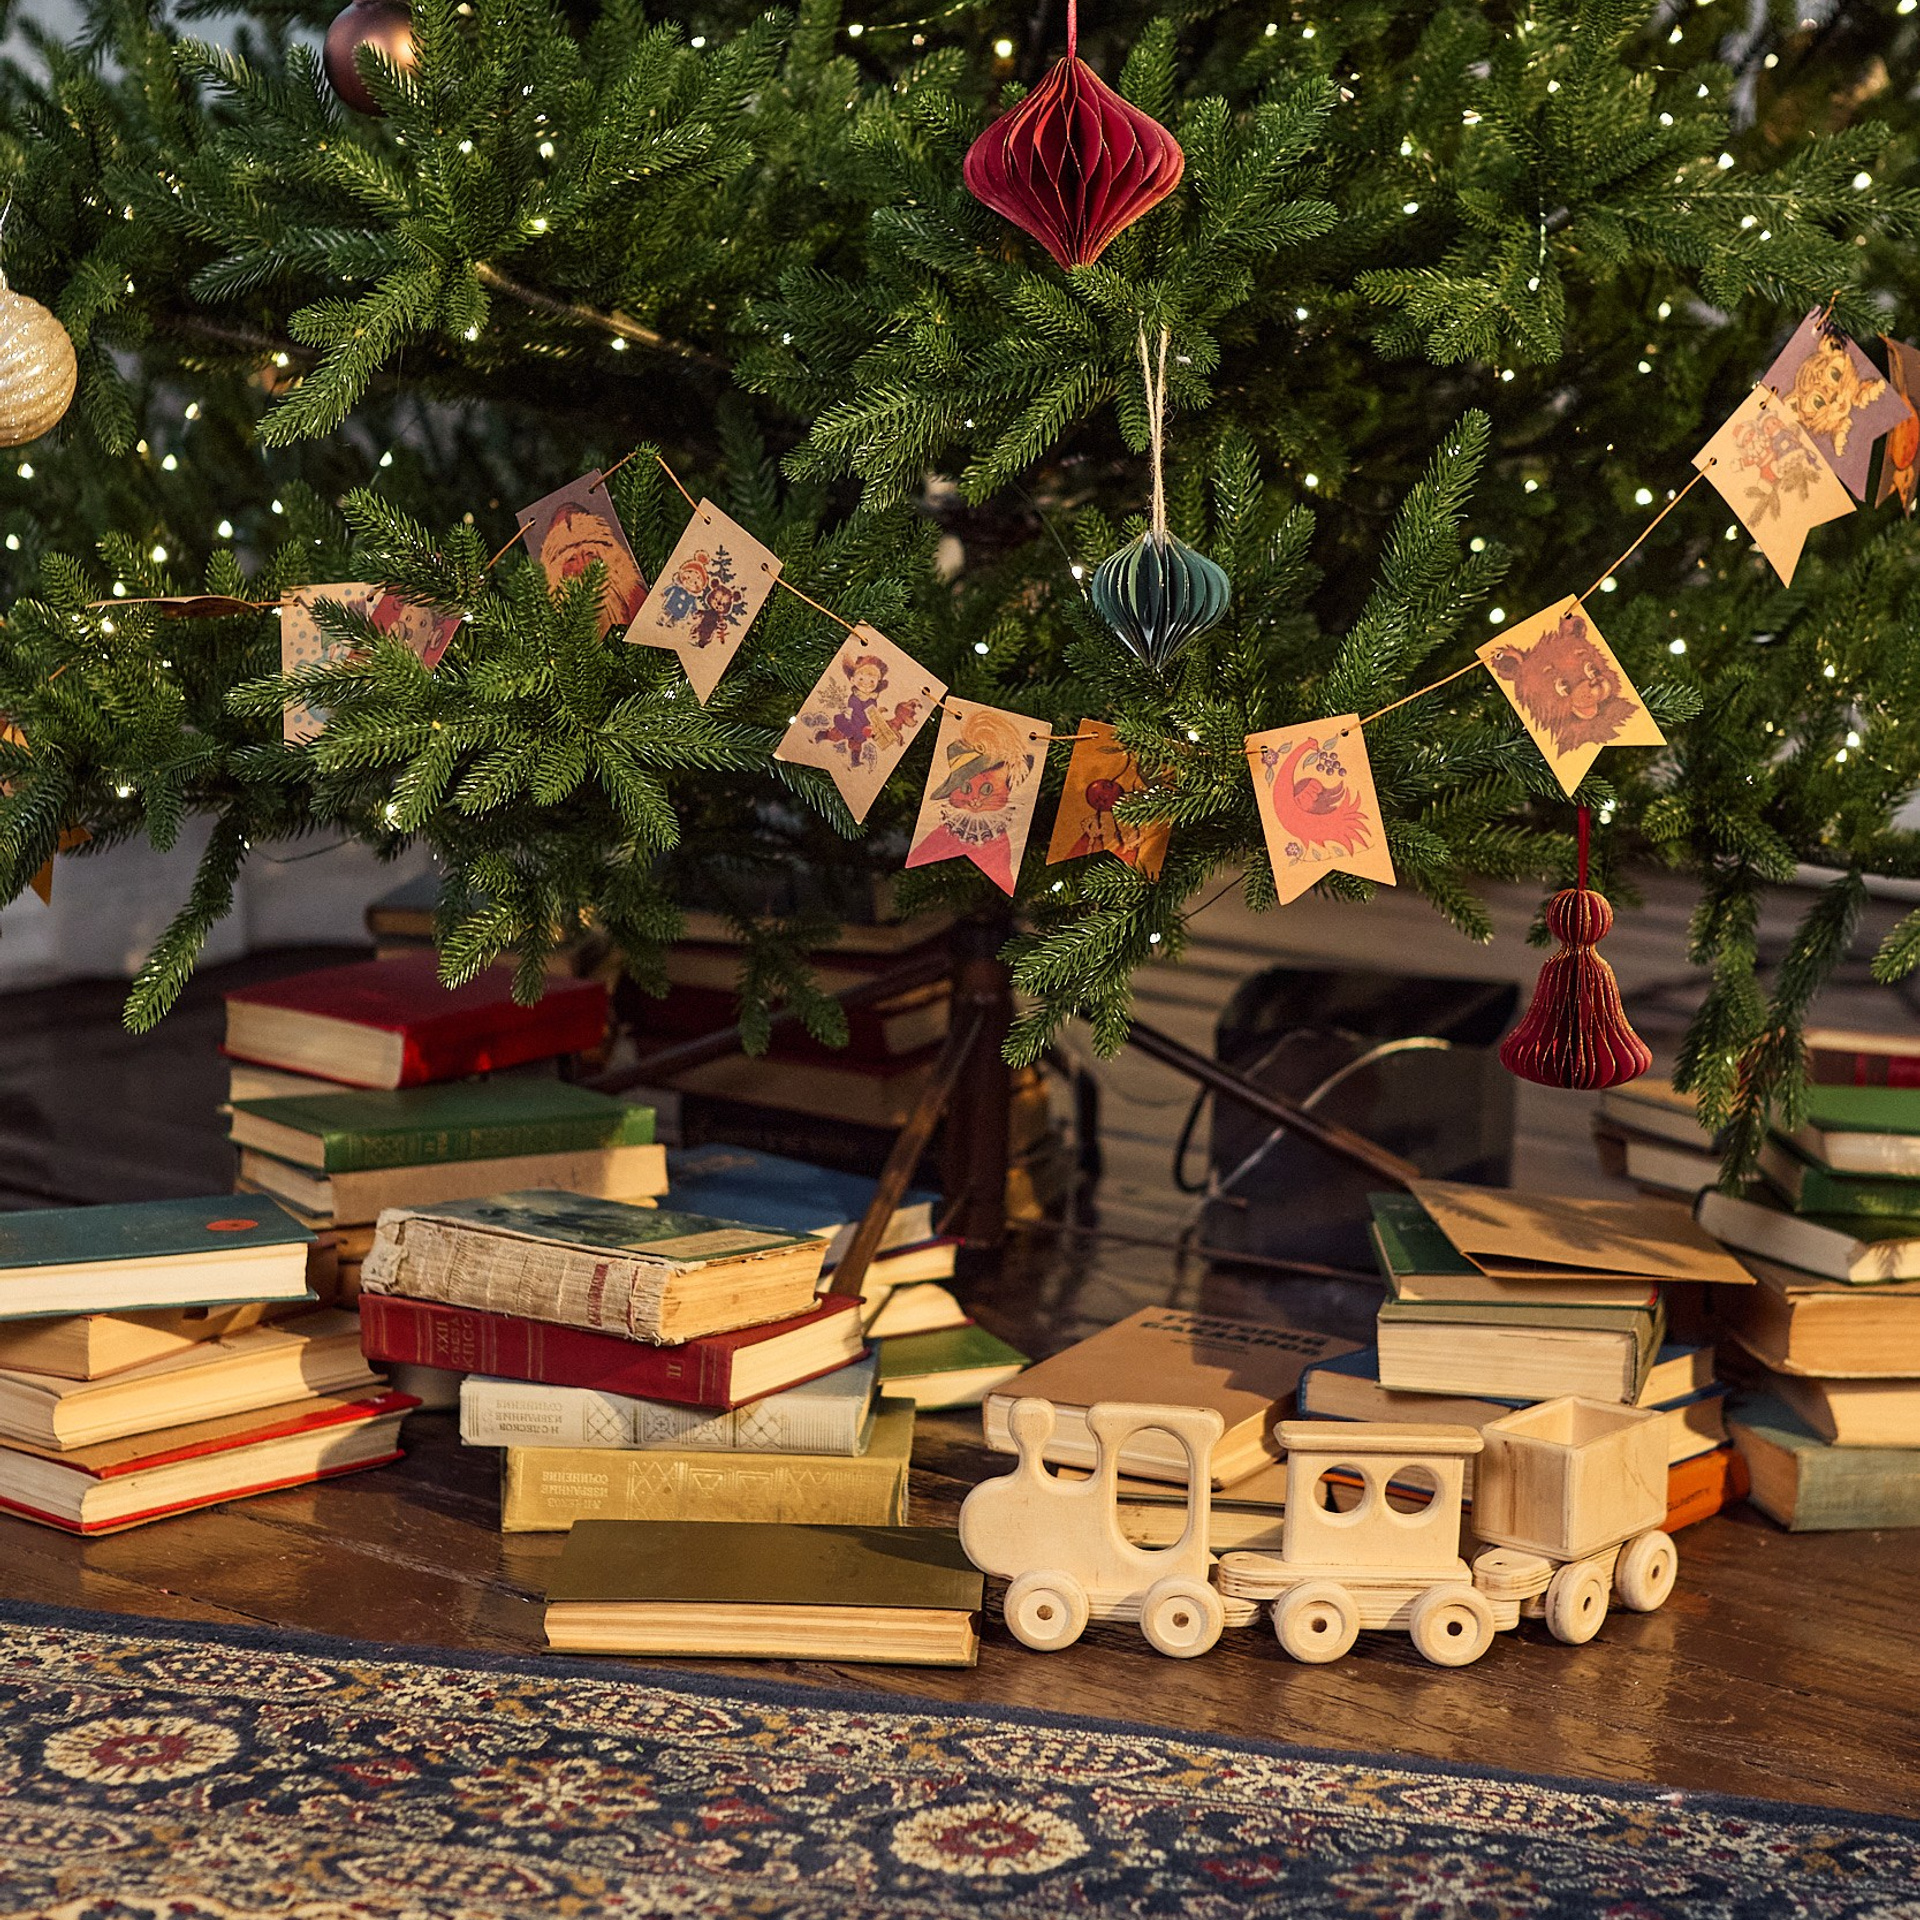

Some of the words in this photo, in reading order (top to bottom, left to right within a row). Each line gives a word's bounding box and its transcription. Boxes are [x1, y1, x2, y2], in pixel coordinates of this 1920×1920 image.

[436, 1320, 449, 1354] XXII
[461, 1315, 475, 1369] КПСС
[495, 1411, 562, 1424] ИЗБРАННЫЕ
[541, 1484, 609, 1498] ИЗБРАННЫЕ
